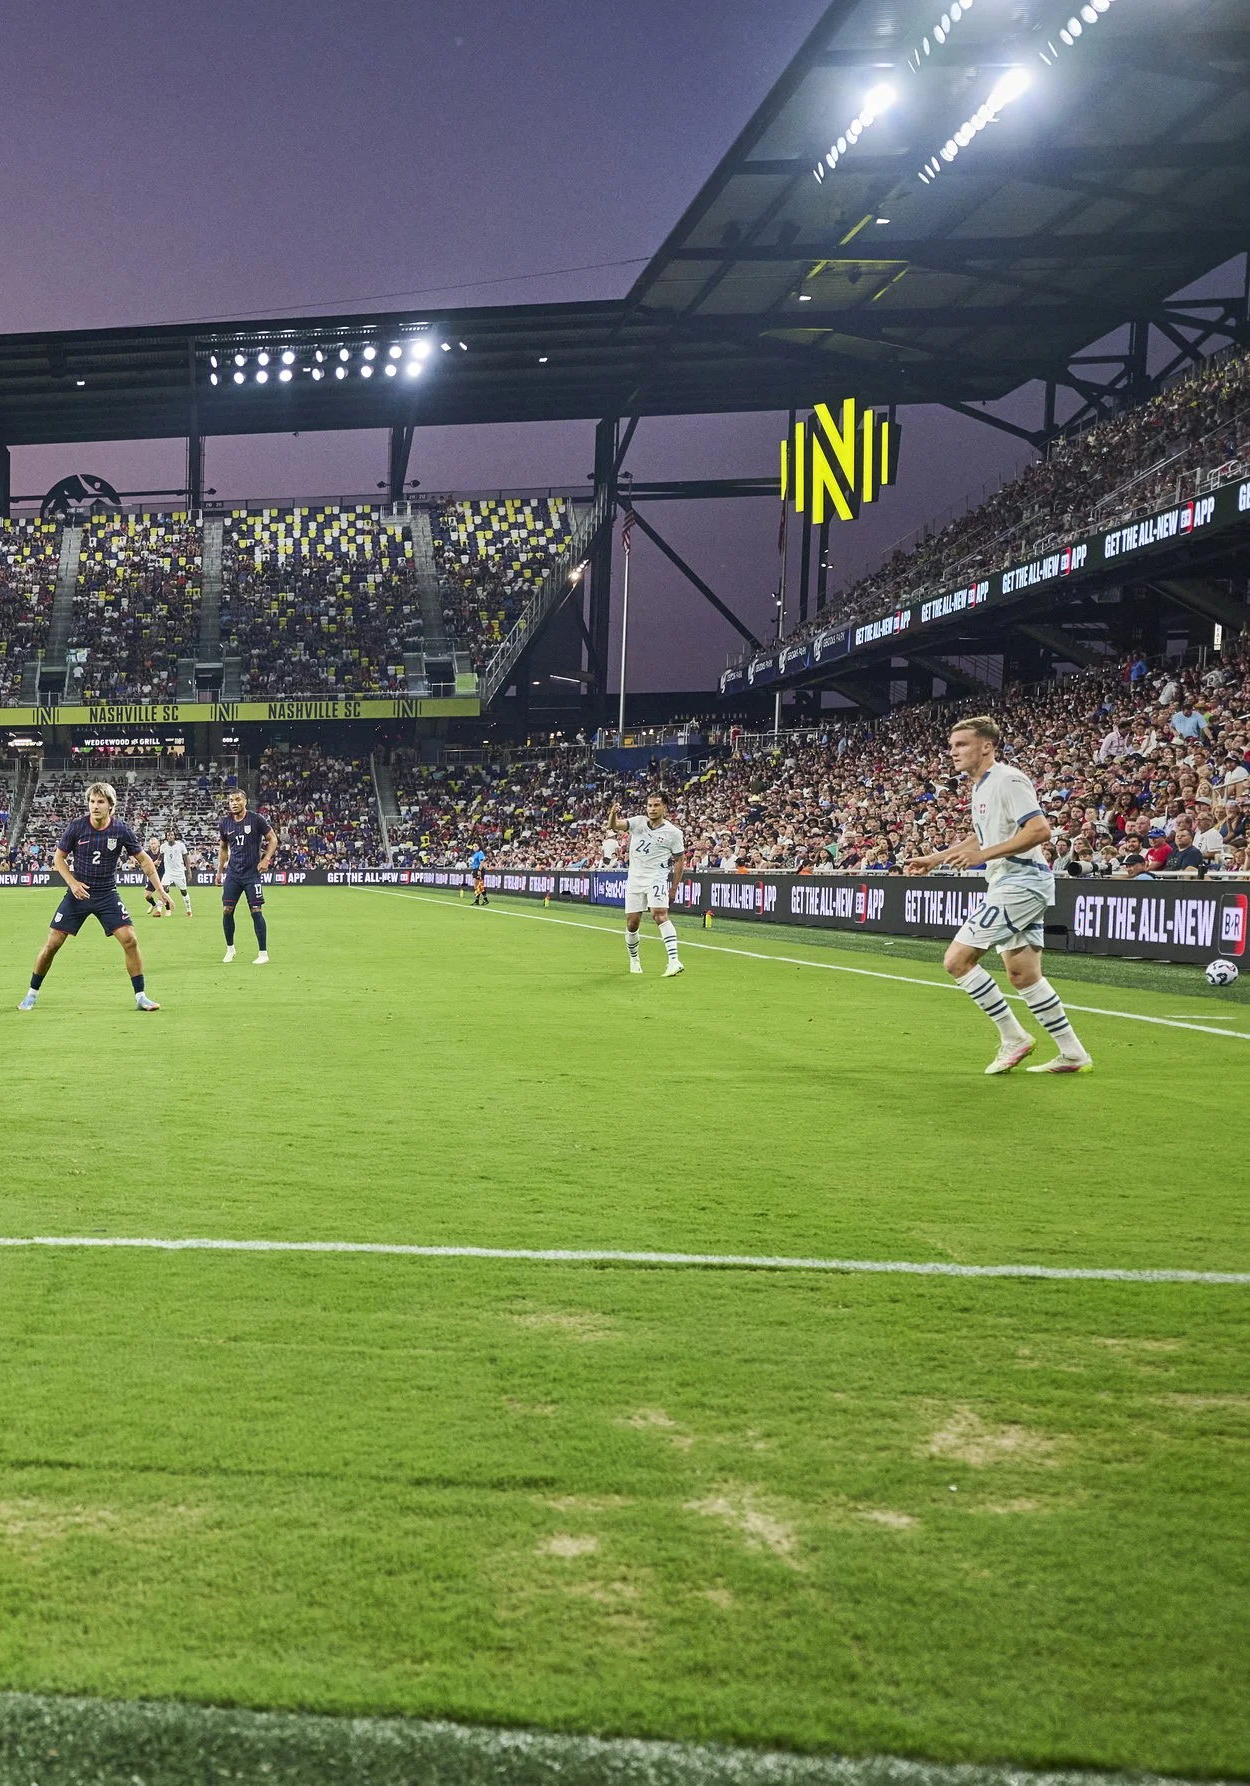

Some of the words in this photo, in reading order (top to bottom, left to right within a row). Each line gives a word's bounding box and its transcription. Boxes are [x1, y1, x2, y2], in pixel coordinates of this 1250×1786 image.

[1104, 531, 1121, 559] GET
[1121, 525, 1139, 553] THE
[1138, 509, 1179, 547] ALL-NEW
[1193, 496, 1215, 528] APP
[1002, 572, 1015, 595] GET
[1015, 566, 1028, 590] THE
[1028, 553, 1060, 585] ALL-NEW
[1070, 544, 1088, 571] APP
[921, 602, 932, 623] GET
[976, 580, 989, 604] APP
[89, 705, 157, 723] NASHVILLE
[163, 705, 179, 721] SC
[268, 702, 339, 719] NASHVILLE
[344, 701, 361, 718] SC
[84, 738, 130, 746] WEDGEWOOD
[139, 737, 161, 745] GRILL
[235, 834, 245, 846] 17
[635, 839, 652, 855] 24
[92, 850, 101, 865] 2
[33, 873, 50, 884] APP
[197, 873, 214, 884] GET
[288, 873, 306, 883] APP
[327, 872, 344, 883] GET
[346, 872, 363, 883] THE
[364, 872, 398, 883] ALL-NEW
[254, 883, 262, 895] 17
[652, 885, 667, 898] 24
[711, 883, 721, 907] GET
[721, 883, 730, 908] THE
[731, 883, 755, 910] ALL-NEW
[764, 885, 777, 912] APP
[791, 885, 805, 914] GET
[805, 886, 820, 916] THE
[819, 886, 854, 918] ALL-NEW
[866, 888, 885, 920] APP
[117, 901, 129, 915] 2
[904, 889, 923, 924] GET
[923, 890, 943, 925] THE
[968, 902, 999, 929] 20
[1074, 895, 1104, 938] GET
[1107, 896, 1137, 941] THE
[1138, 898, 1217, 947] ALL-NEW
